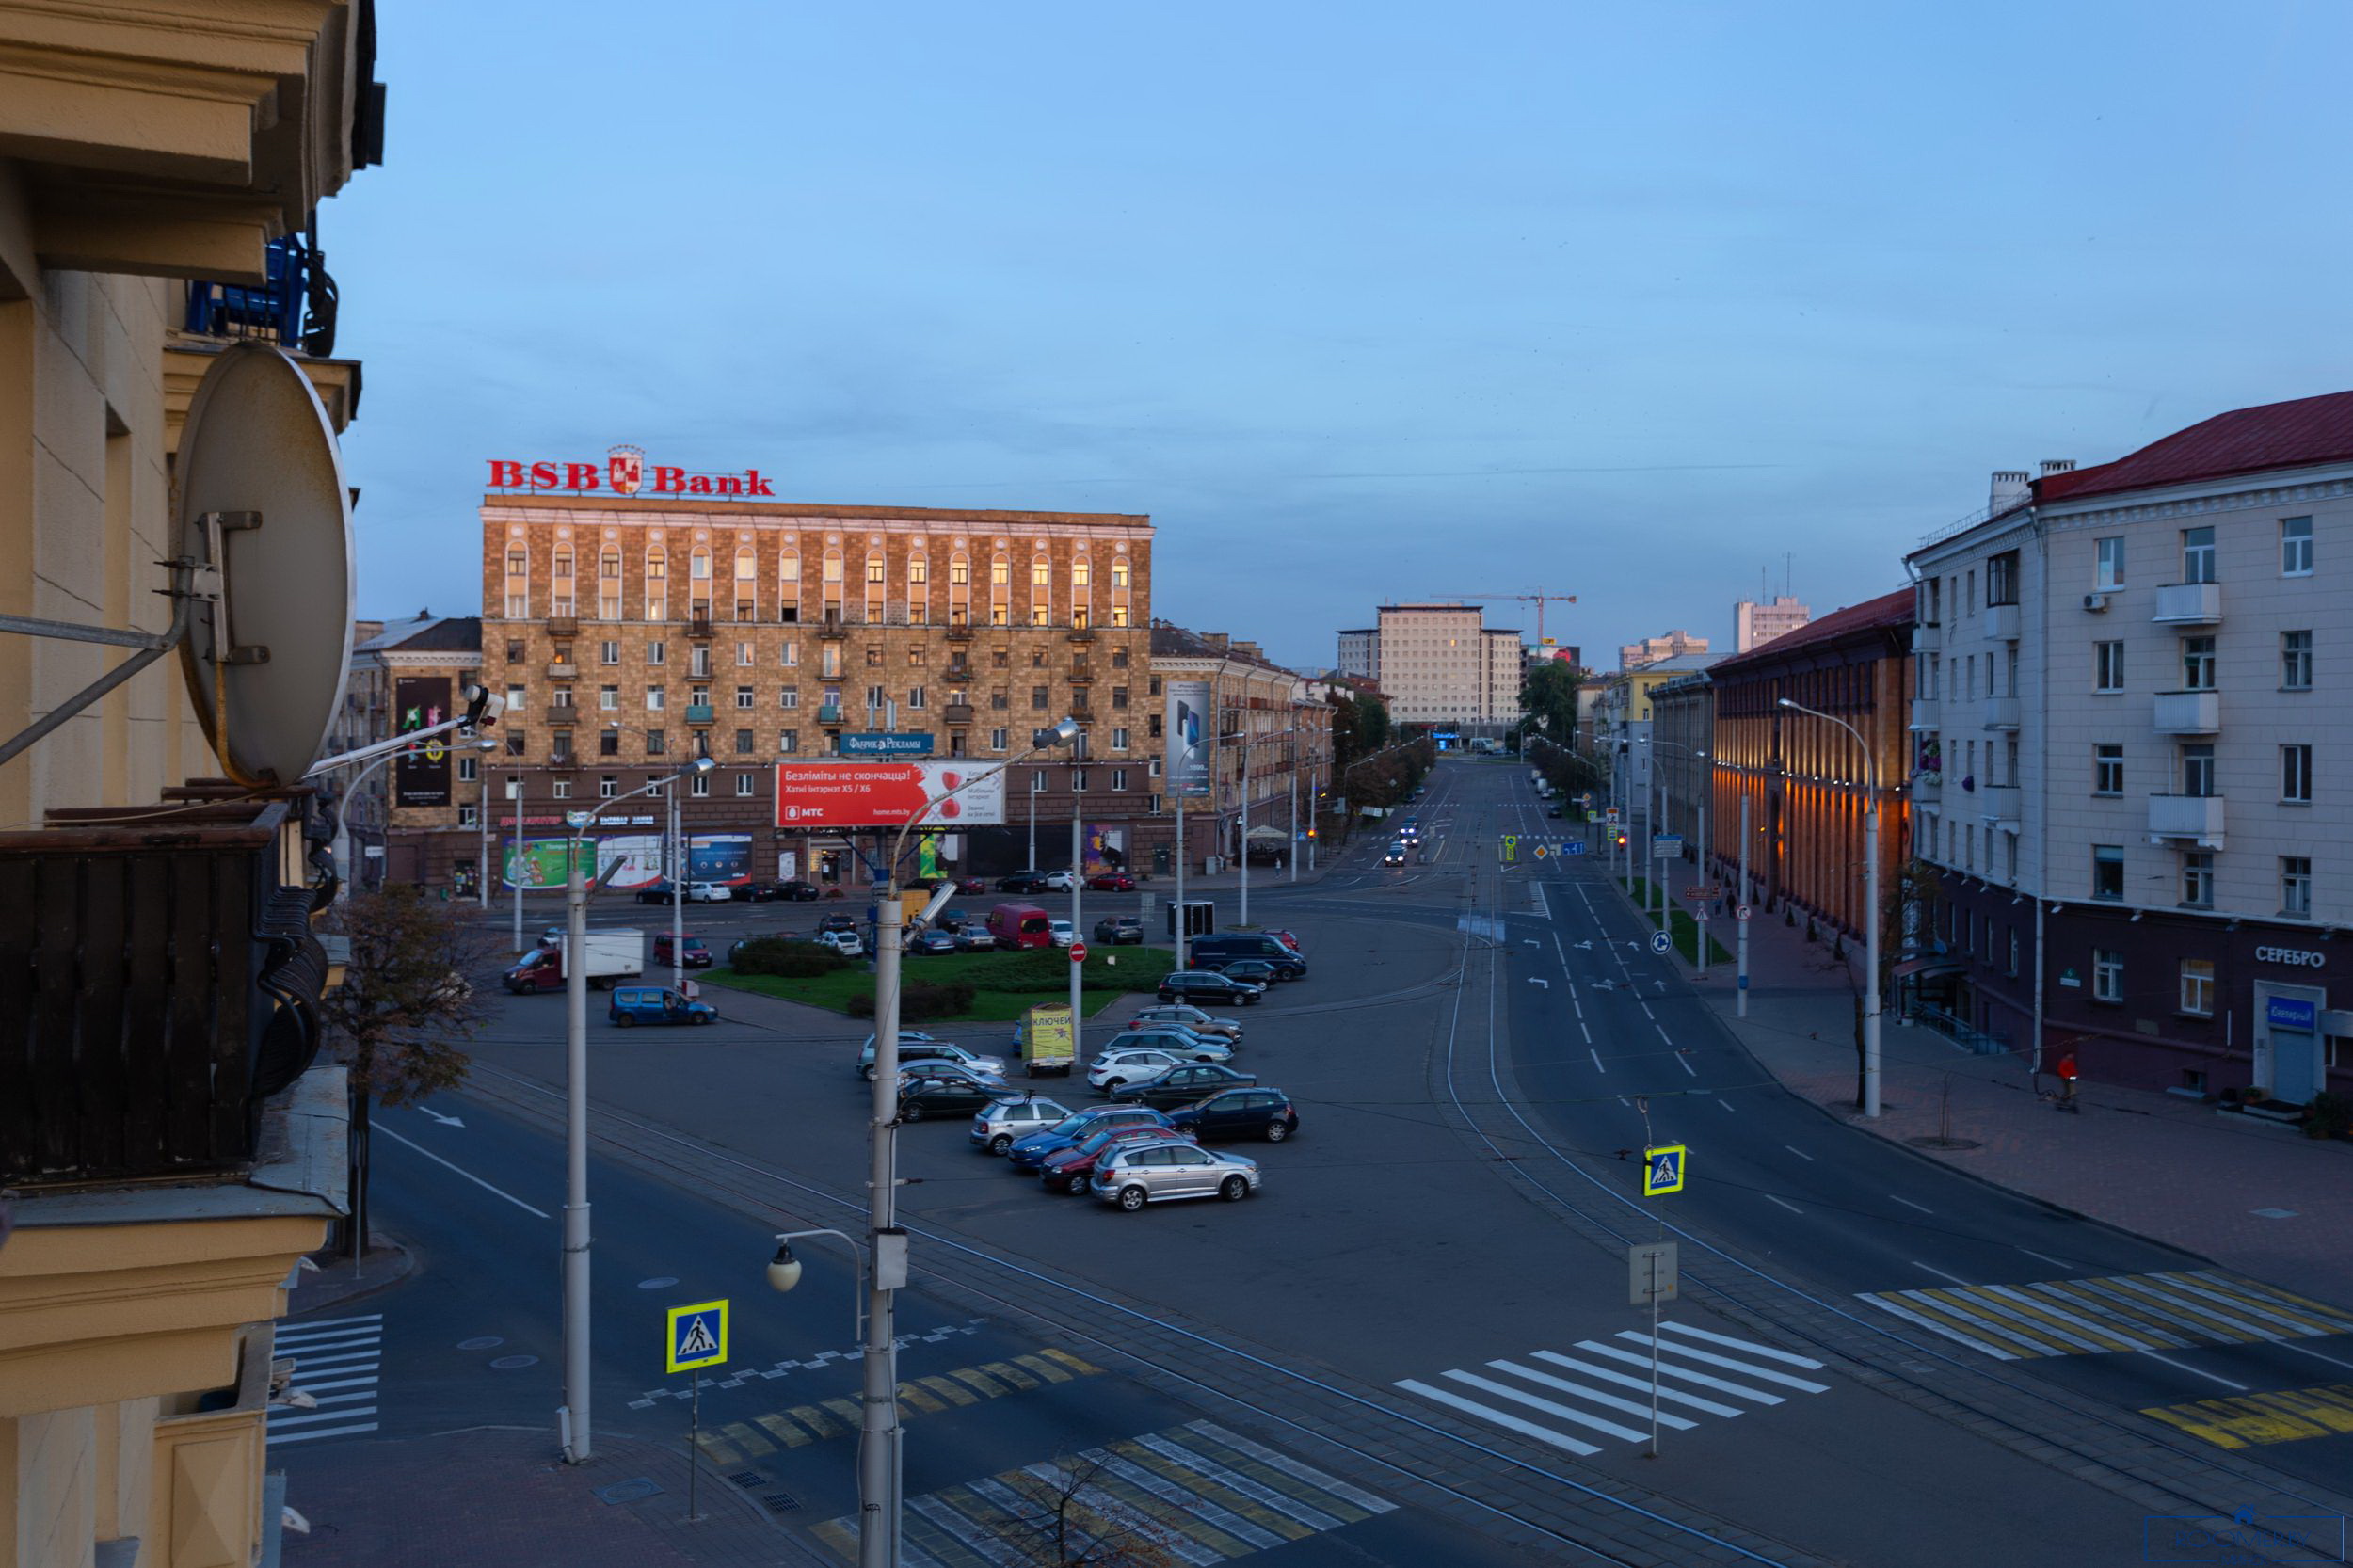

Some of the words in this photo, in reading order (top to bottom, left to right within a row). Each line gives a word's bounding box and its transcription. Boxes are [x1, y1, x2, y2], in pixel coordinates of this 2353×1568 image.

[486, 459, 600, 491] BSB
[650, 466, 776, 496] Bank
[785, 770, 837, 781] Безліміты
[838, 773, 852, 781] не
[853, 770, 911, 783] скончацца!
[785, 785, 807, 793] Хатні
[802, 808, 824, 817] МТС
[2255, 946, 2326, 968] СЕРЕБРО
[1032, 1016, 1071, 1026] КЛЮЧЕЙ
